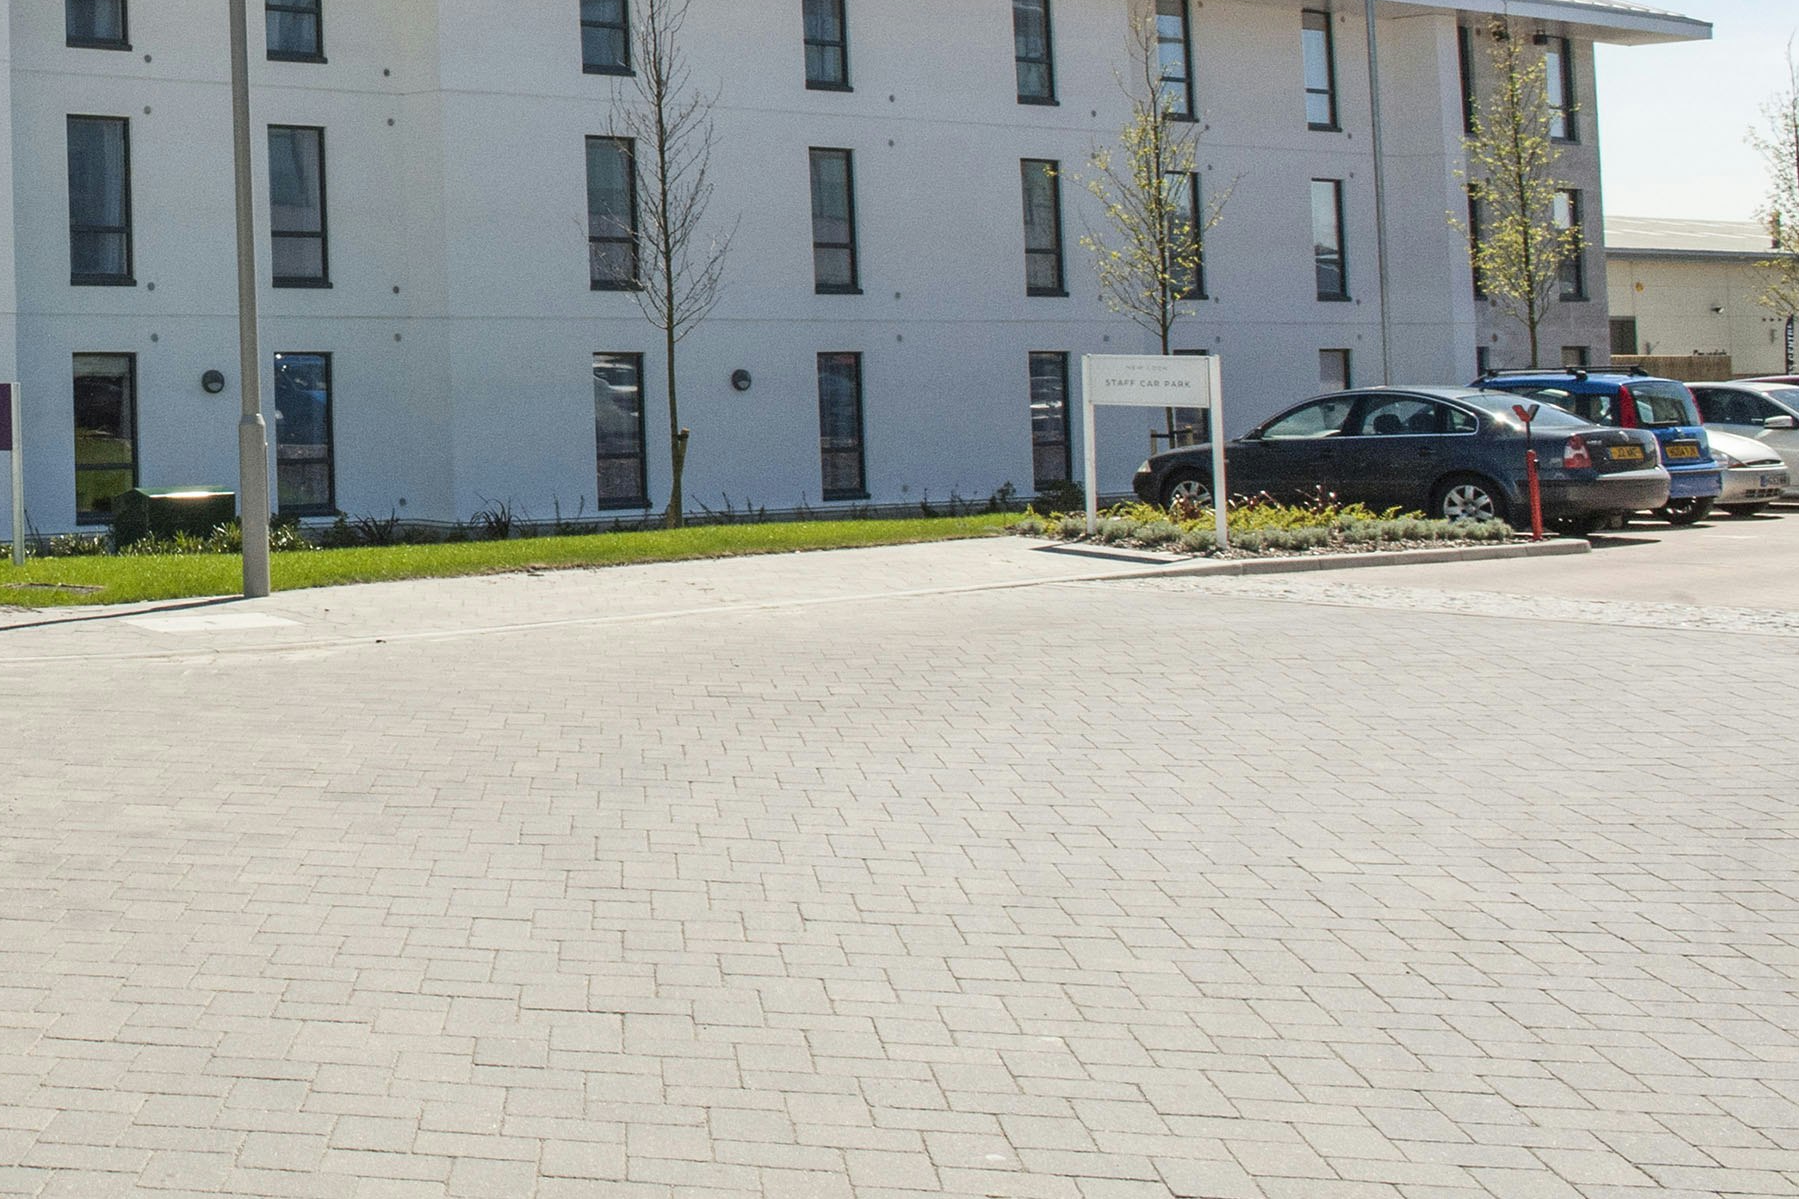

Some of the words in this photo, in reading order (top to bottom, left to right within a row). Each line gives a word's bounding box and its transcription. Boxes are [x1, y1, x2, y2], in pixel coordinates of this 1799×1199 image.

[1105, 379, 1135, 387] STAFF
[1140, 379, 1160, 388] CAR
[1164, 380, 1191, 389] PARK
